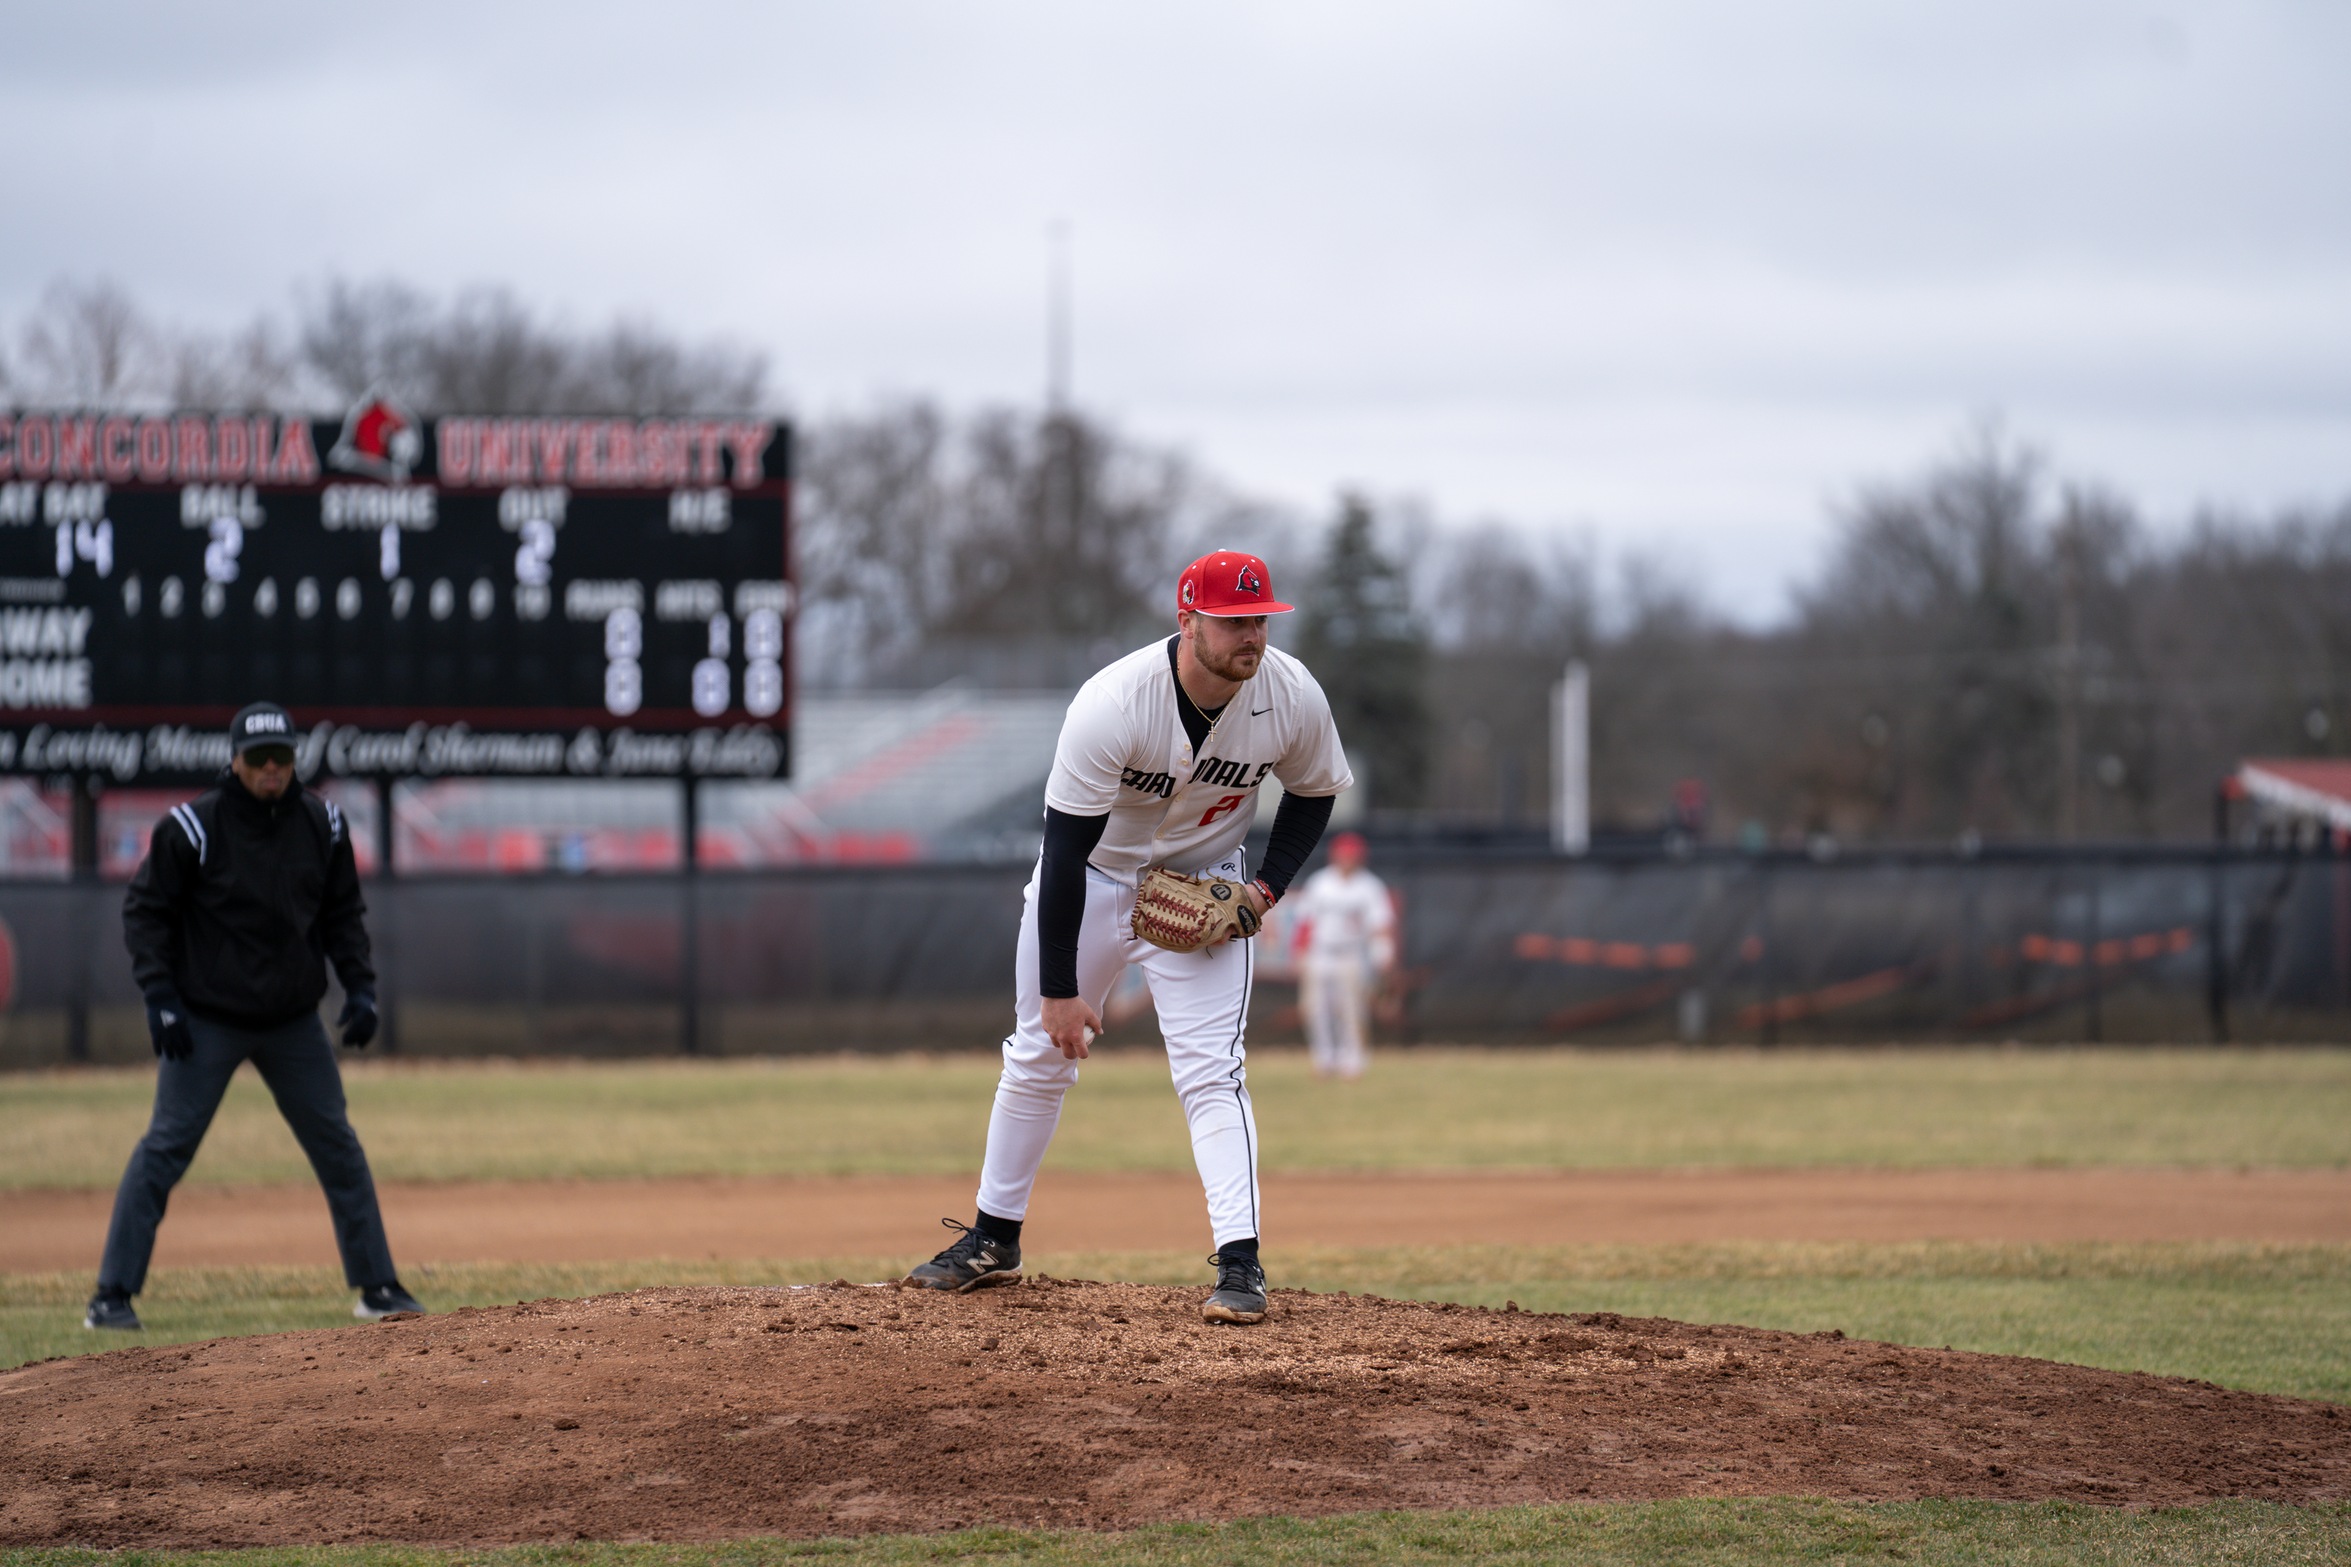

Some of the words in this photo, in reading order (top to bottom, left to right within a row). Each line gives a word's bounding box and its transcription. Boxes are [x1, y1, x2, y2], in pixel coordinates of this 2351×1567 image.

[437, 417, 777, 487] UNIVERSITY
[180, 484, 267, 528] BALL
[321, 484, 440, 531] STRIKE
[498, 486, 570, 532] OUT
[56, 517, 113, 579] 14
[204, 514, 243, 583] 2
[380, 519, 399, 581] 1
[515, 518, 556, 586] 2
[0, 606, 93, 656] WAY
[0, 655, 93, 709] OME
[22, 722, 143, 782] Loving
[327, 721, 428, 776] Carol
[566, 725, 600, 774] &
[1197, 794, 1246, 827] 2
